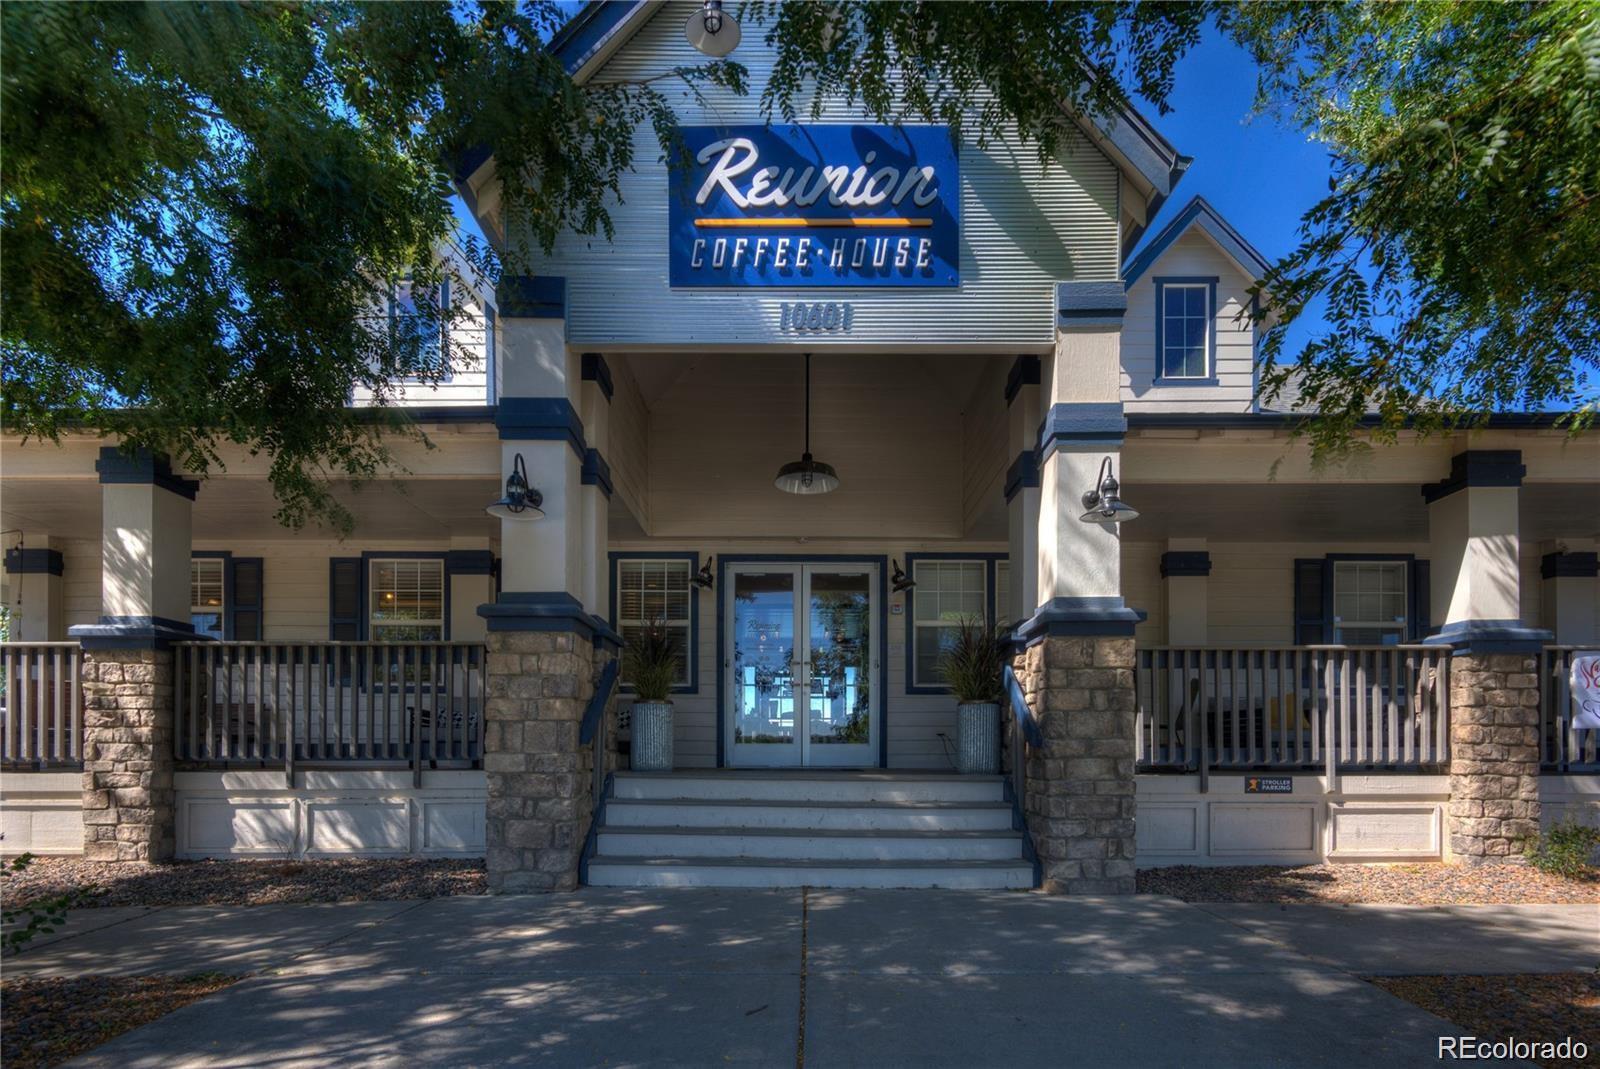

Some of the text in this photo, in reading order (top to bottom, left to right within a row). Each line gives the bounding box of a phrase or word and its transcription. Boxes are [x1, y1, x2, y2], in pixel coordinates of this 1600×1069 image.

[696, 137, 938, 208] Reunion
[691, 238, 931, 267] COFFEE HOUSE
[780, 302, 851, 329] 10601
